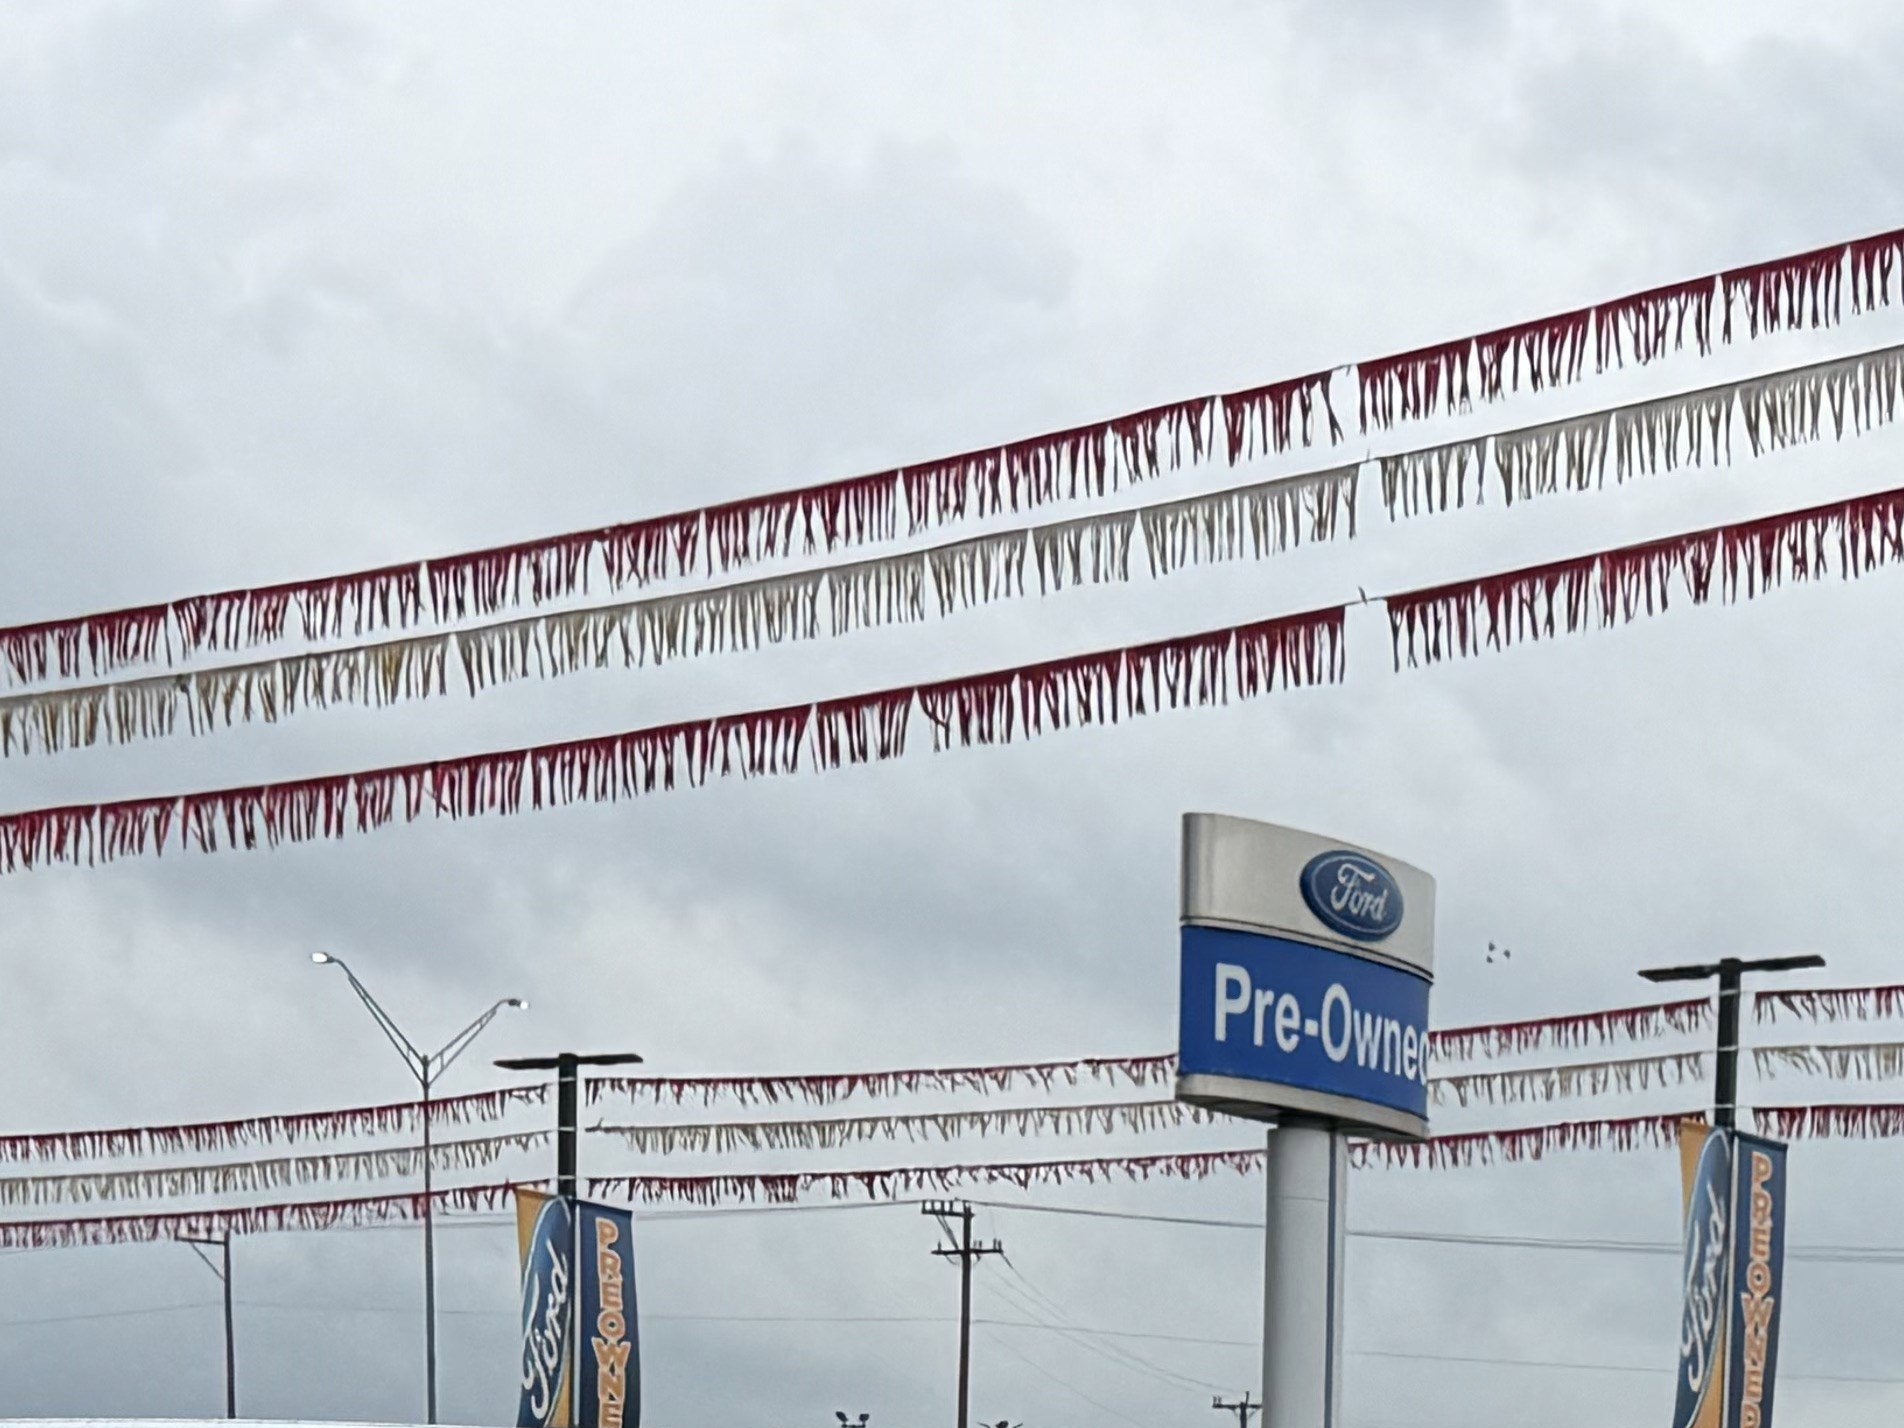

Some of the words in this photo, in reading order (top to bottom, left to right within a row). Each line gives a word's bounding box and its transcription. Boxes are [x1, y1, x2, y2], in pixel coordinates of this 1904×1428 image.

[1331, 863, 1389, 922] Ford
[522, 1239, 568, 1420] Ford
[1680, 1183, 1725, 1392] Ford
